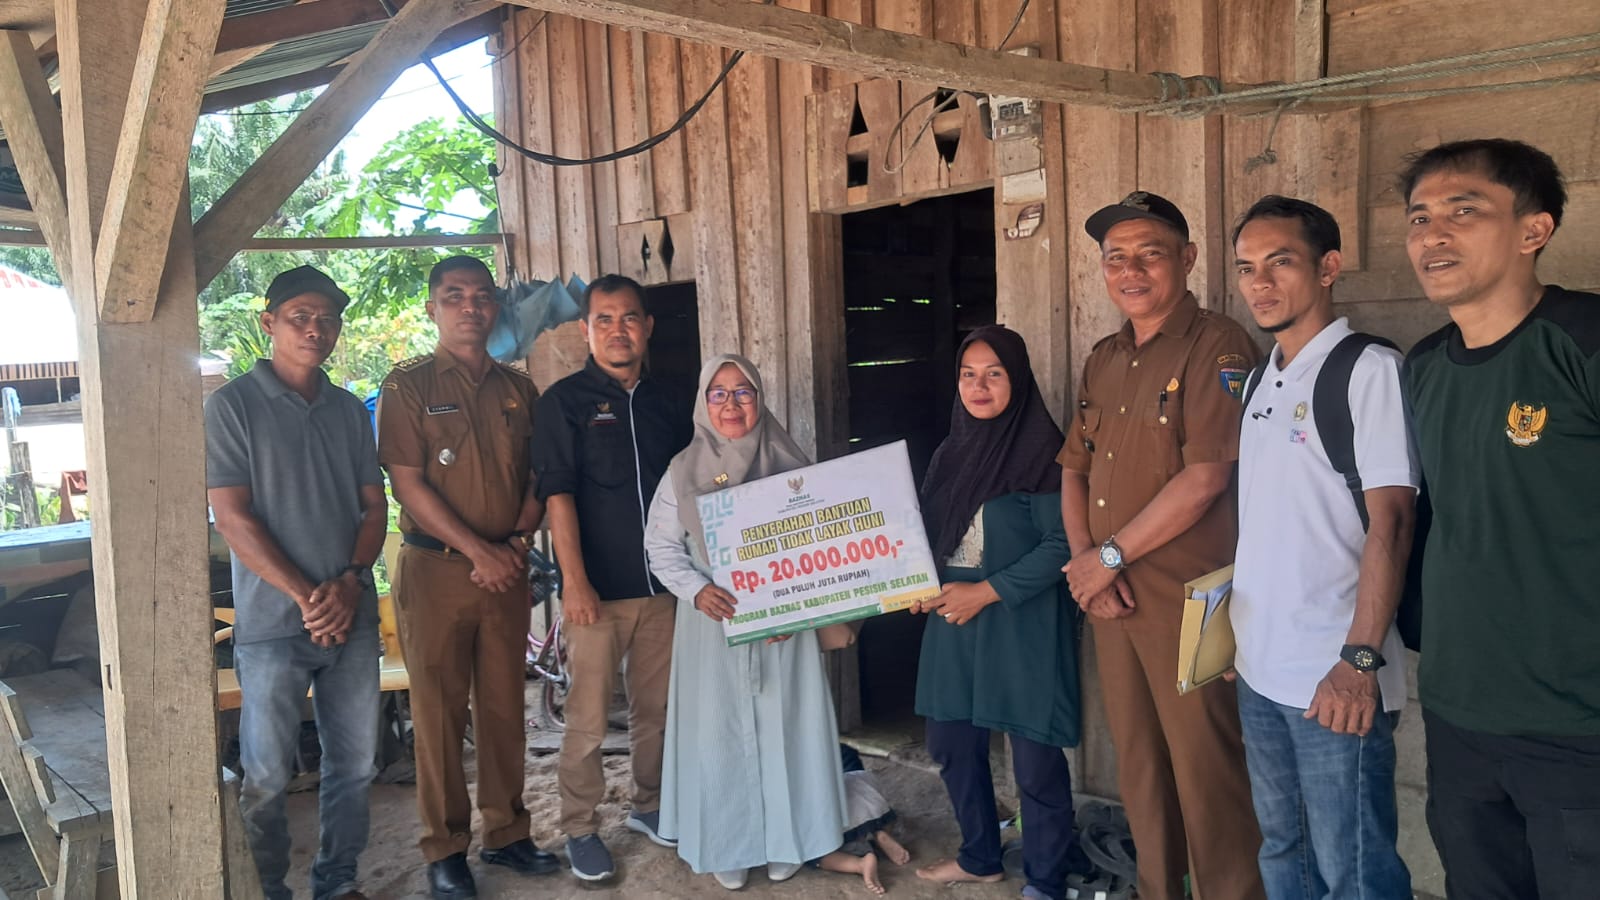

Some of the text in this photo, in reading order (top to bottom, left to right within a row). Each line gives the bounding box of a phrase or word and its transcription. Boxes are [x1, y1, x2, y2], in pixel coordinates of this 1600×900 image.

[736, 511, 885, 561] RUMAH TIDAK LAYAK HUNI
[741, 512, 814, 544] PENYERAHAN
[815, 497, 872, 523] BANTUAN
[731, 534, 904, 593] Rp. 20.000.000,-
[773, 569, 870, 599] (DUA PULUH JUTA RUPIAH)
[770, 601, 802, 616] BAZNAS
[803, 590, 851, 608] KABUPATEN
[854, 582, 888, 597] PESISIR
[890, 572, 929, 589] SELATAN
